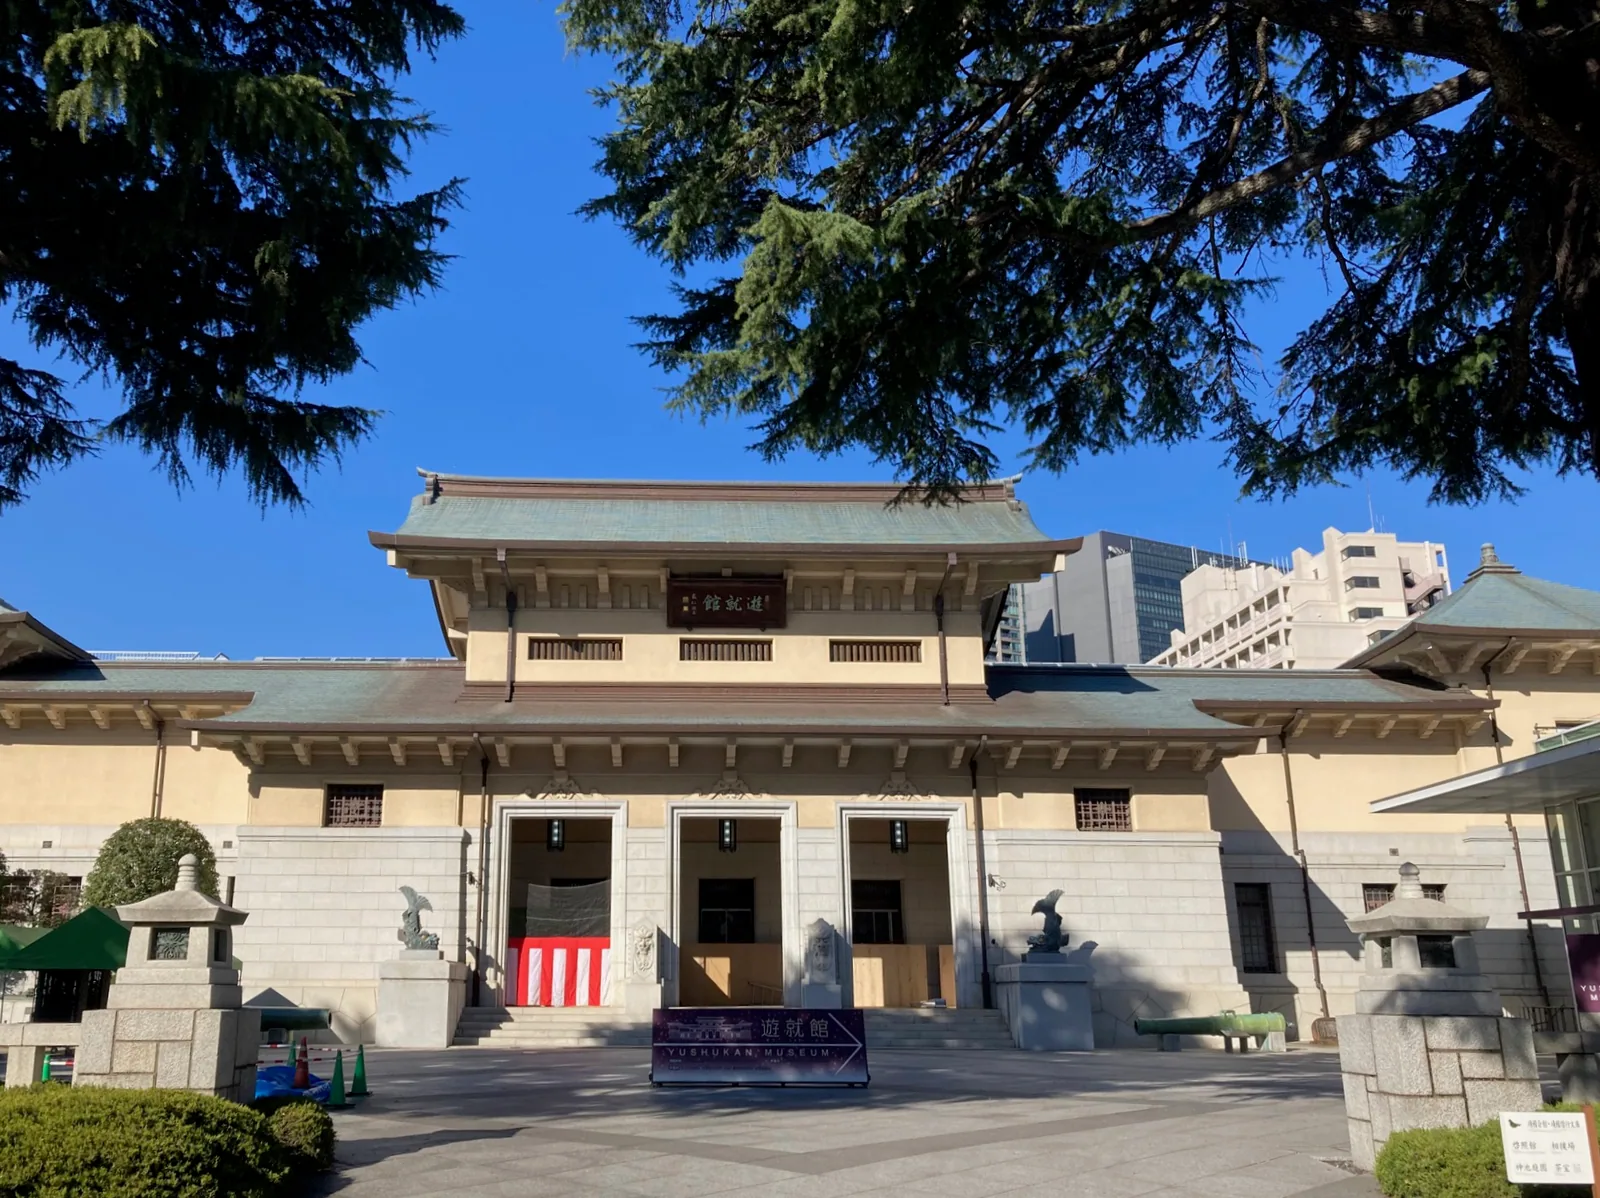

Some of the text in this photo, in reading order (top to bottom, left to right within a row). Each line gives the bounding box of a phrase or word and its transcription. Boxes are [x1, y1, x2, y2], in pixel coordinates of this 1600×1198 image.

[761, 1018, 829, 1038] 遊就館
[668, 1048, 830, 1057] YUSHUKAN MUSEUM
